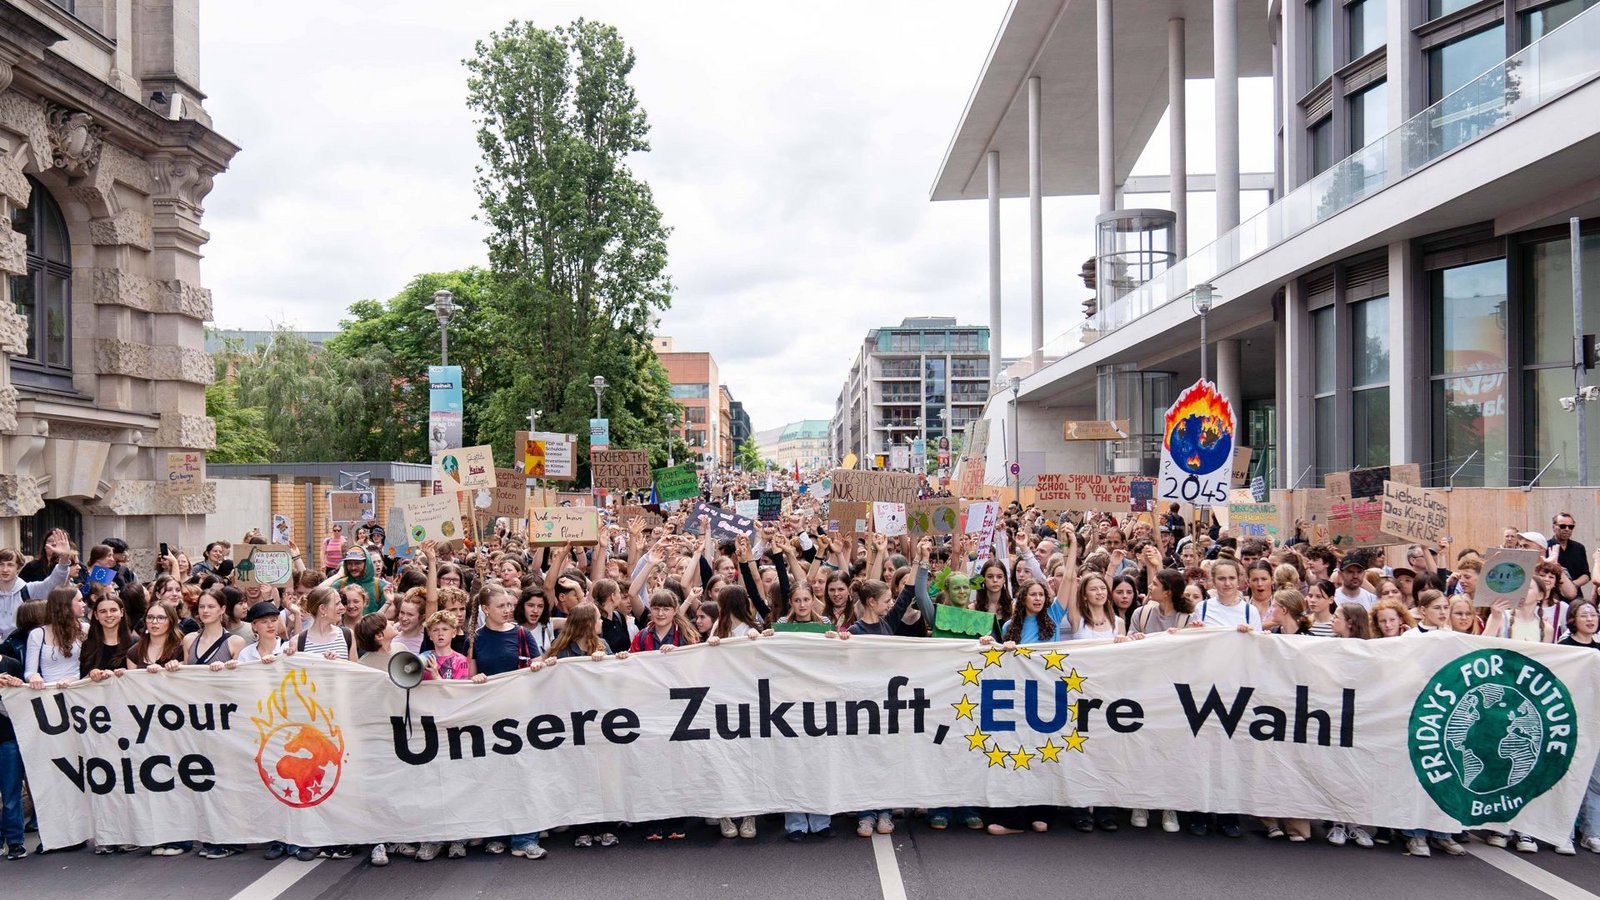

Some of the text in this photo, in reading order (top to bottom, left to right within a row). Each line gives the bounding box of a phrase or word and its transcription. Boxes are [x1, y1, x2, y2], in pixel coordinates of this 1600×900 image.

[1036, 483, 1069, 492] SCHOOL
[1089, 484, 1107, 493] YOU
[1068, 475, 1101, 484] SHOULD
[1163, 475, 1227, 502] 2045
[496, 489, 516, 499] Roten
[833, 484, 854, 502] NUR
[1040, 492, 1071, 500] LISTEN
[1094, 494, 1112, 502] THE
[1386, 484, 1422, 505] Liebes
[498, 501, 519, 514] Liste
[534, 512, 547, 520] We
[1384, 502, 1402, 516] Das
[1405, 506, 1425, 522] Klima
[1386, 520, 1401, 533] eine
[1407, 519, 1440, 543] KRISE
[30, 692, 238, 744] Use your
[390, 676, 1355, 766] Unsere Zukunft, EUre Wahl
[1416, 655, 1571, 784] FRIDAYS FOR FUTURE
[52, 737, 216, 794] voice
[1471, 795, 1523, 816] Berlin
